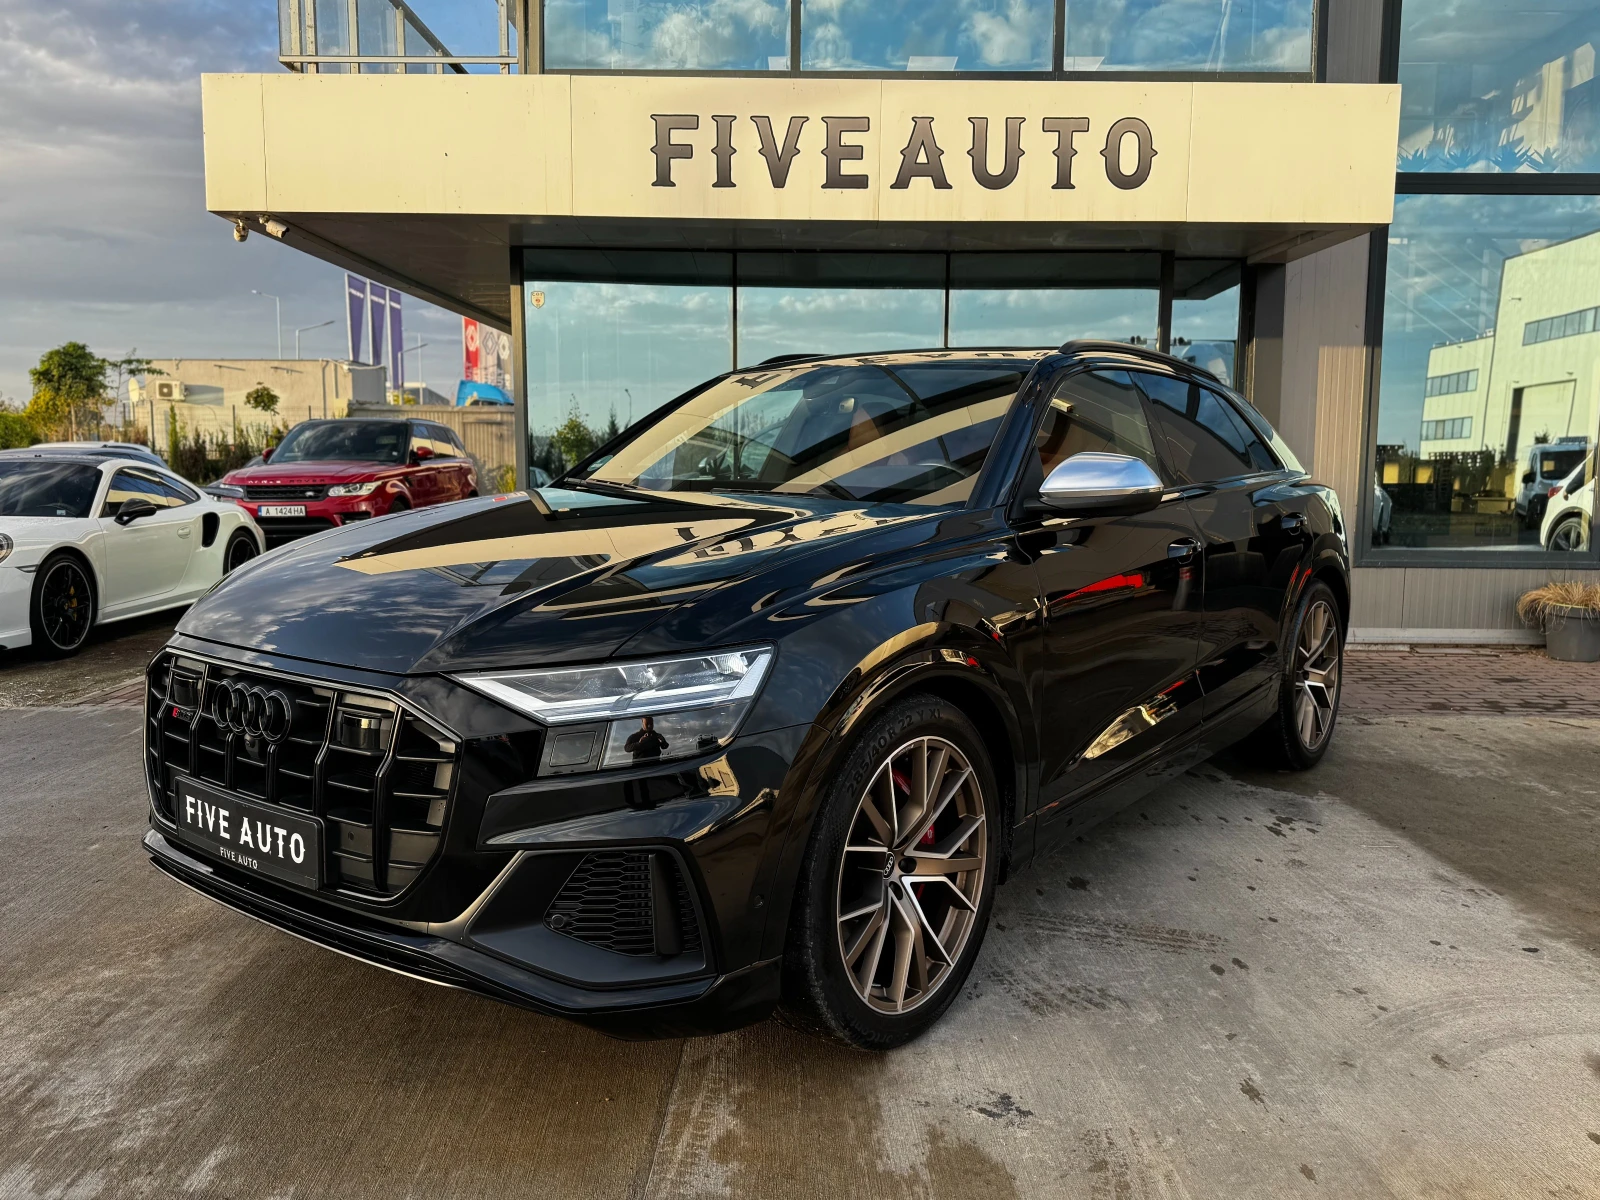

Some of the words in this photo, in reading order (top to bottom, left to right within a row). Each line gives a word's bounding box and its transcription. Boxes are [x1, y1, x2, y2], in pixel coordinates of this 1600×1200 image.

[265, 507, 271, 515] A
[898, 714, 914, 730] 22
[185, 794, 231, 840] FIVE
[239, 816, 306, 864] AUTO
[219, 846, 236, 861] FIVE
[237, 855, 258, 870] AUTO
